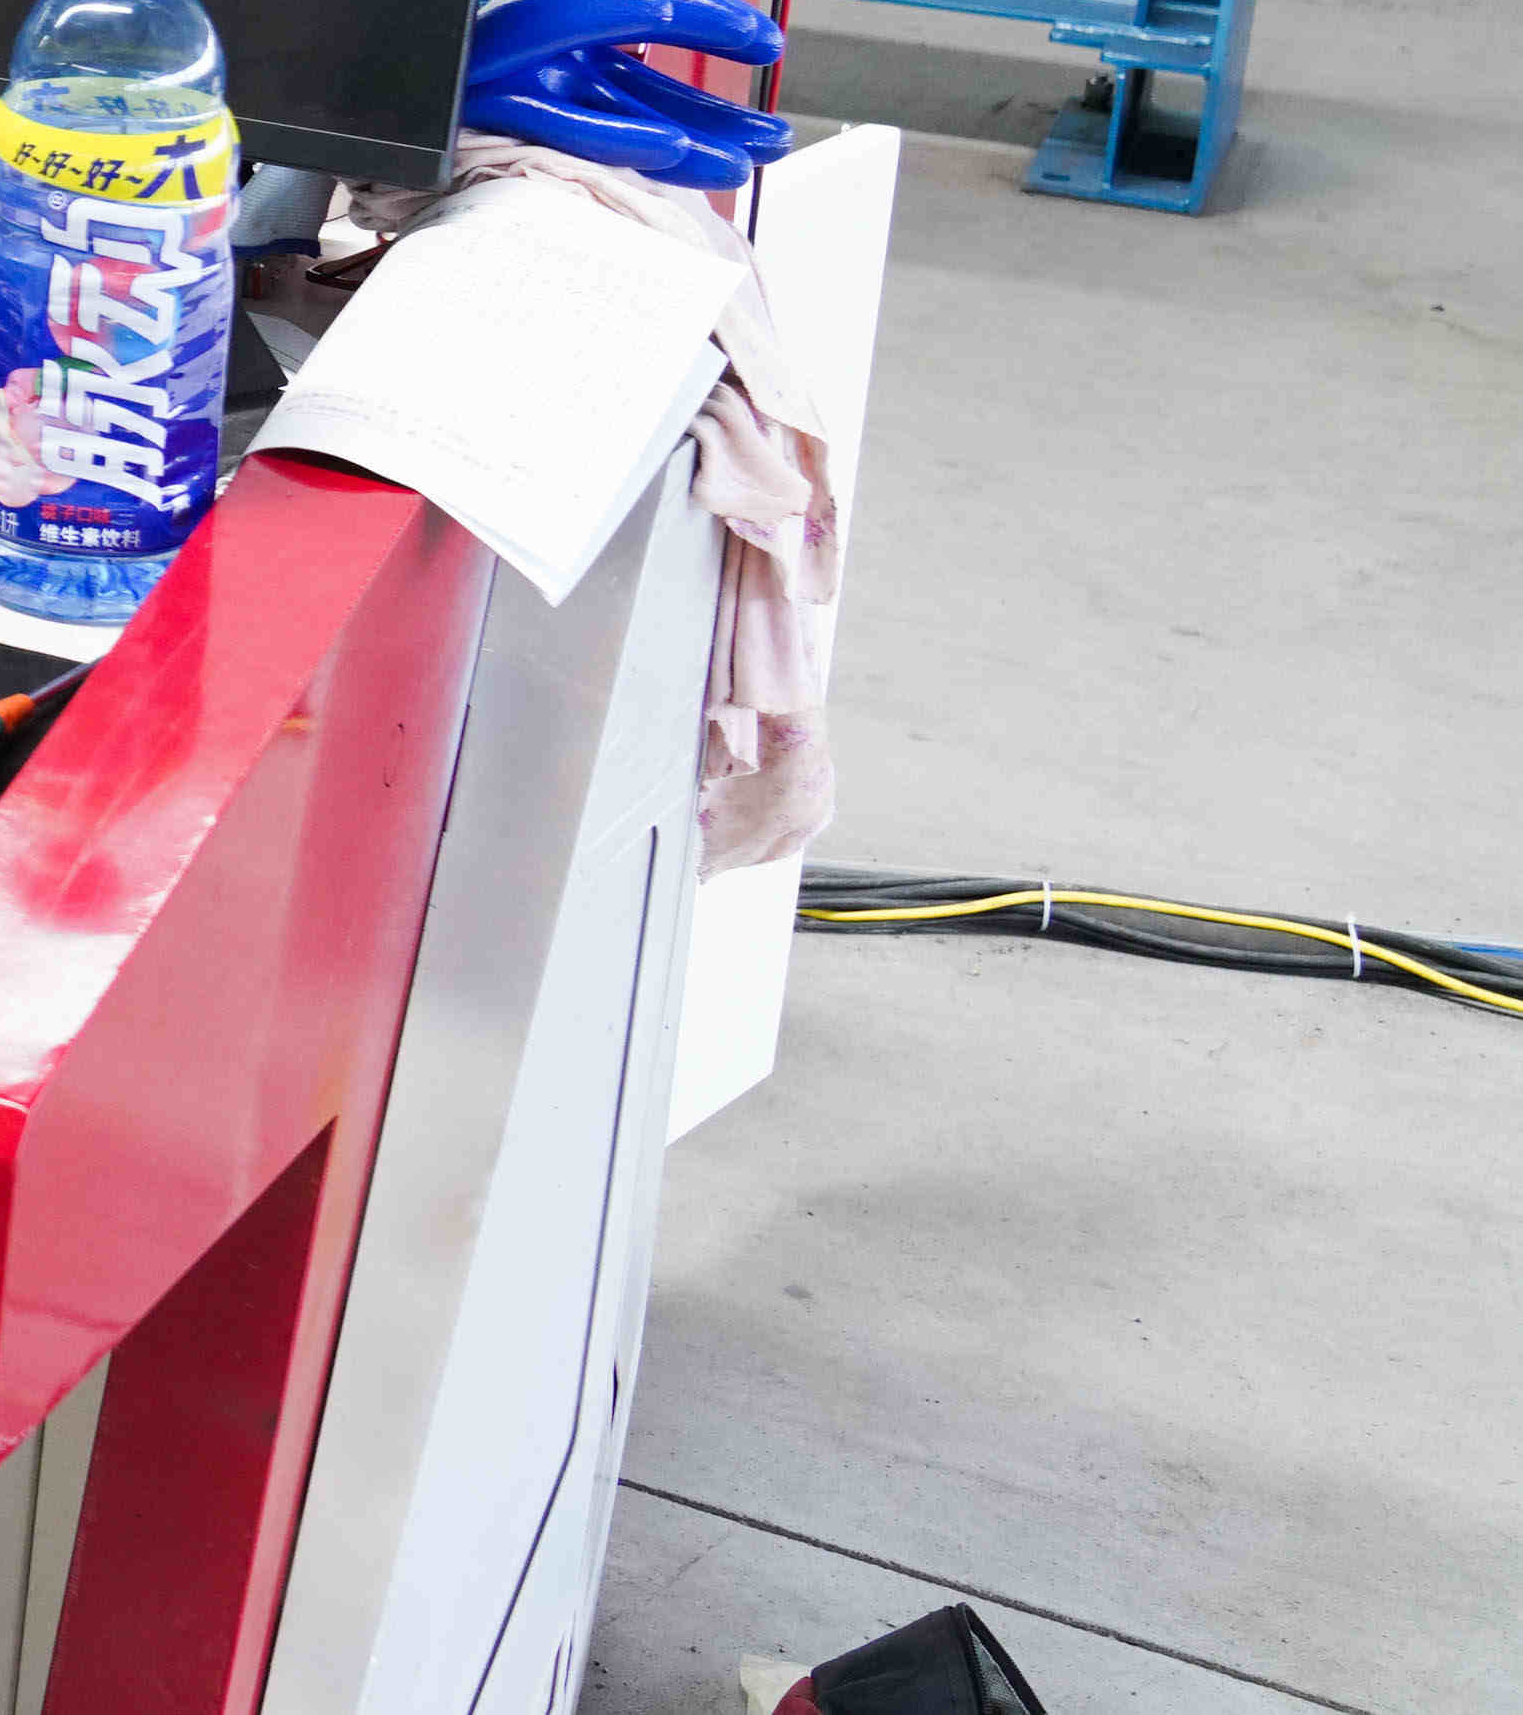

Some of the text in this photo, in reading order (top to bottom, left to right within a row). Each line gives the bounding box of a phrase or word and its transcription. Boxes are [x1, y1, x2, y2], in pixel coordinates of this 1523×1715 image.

[40, 503, 111, 524] 桃子口味
[39, 524, 141, 548] 维生素饮料
